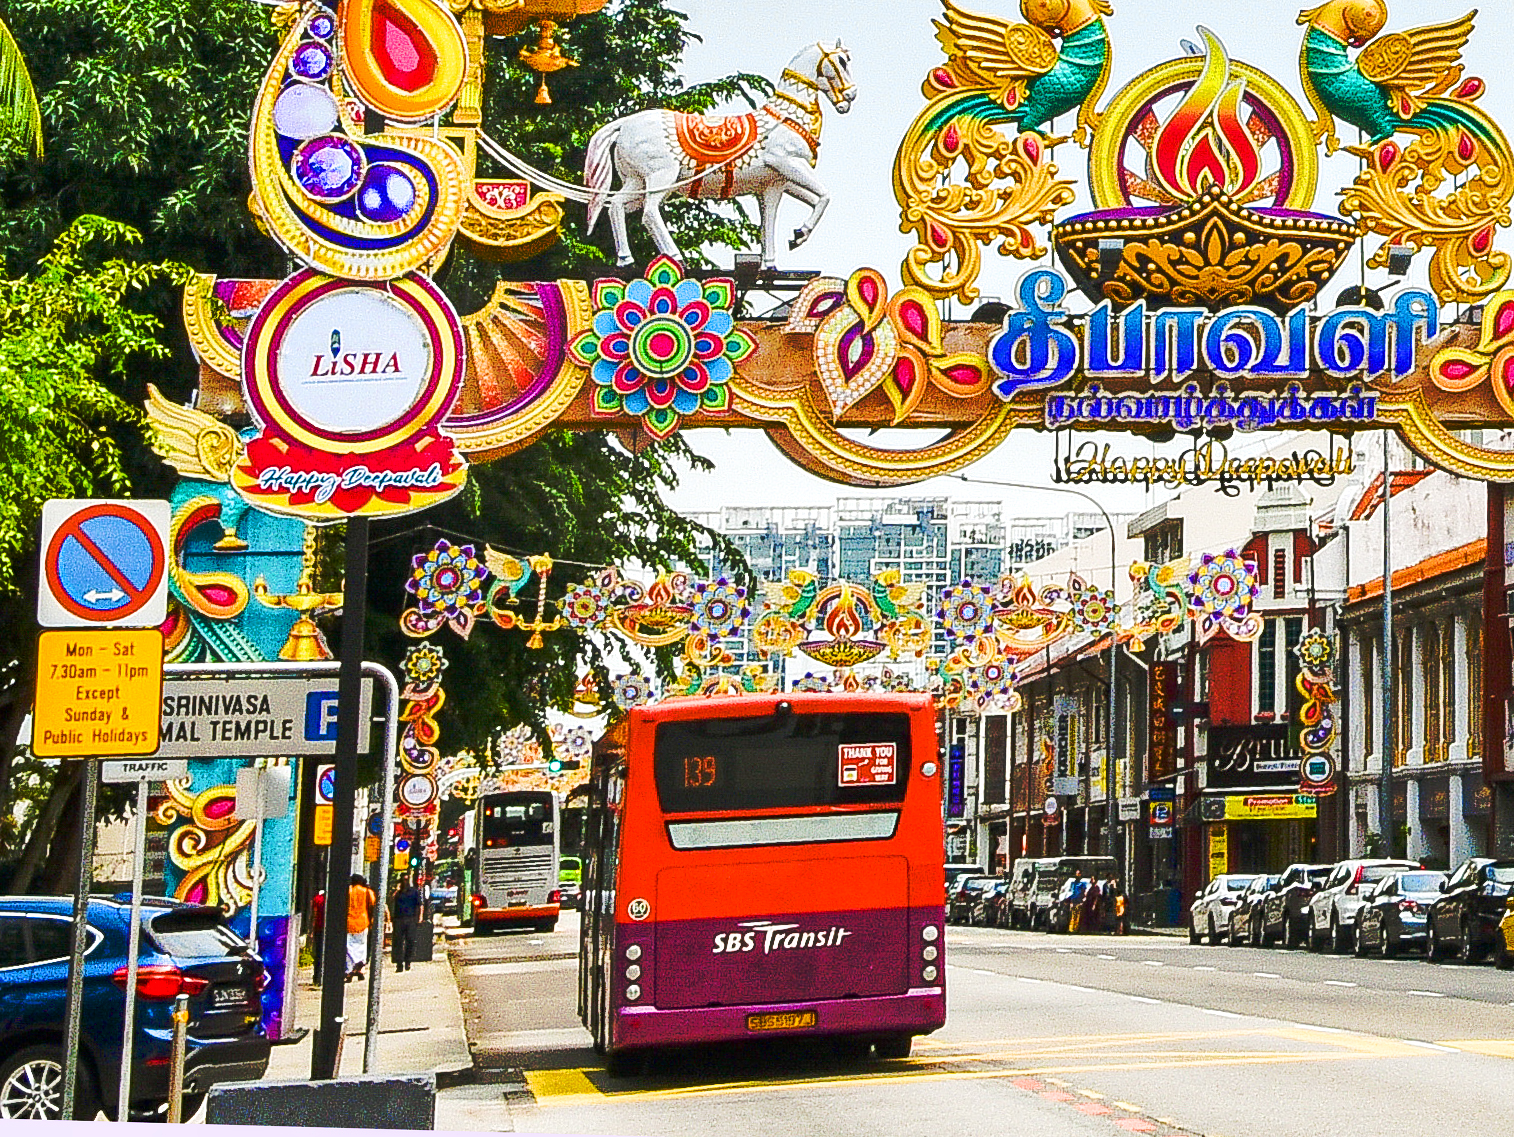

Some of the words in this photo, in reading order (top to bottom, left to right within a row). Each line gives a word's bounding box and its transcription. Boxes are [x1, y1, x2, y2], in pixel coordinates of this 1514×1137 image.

[989, 267, 1440, 400] தீபாவளி
[1065, 441, 1188, 487] Happy
[259, 466, 338, 504] Happy
[341, 463, 443, 492] Deepavali
[66, 642, 93, 657] Mon
[113, 642, 135, 657] Sat
[50, 664, 97, 680] 7.30am
[117, 662, 149, 680] 11pm
[76, 686, 121, 702] Except
[64, 707, 112, 724] Sunday
[121, 707, 130, 720] &
[163, 694, 271, 717] SRINIVASA
[43, 730, 84, 745] Public
[92, 729, 149, 744] Holidays
[209, 718, 294, 742] TEMPLE
[843, 747, 873, 759] THANK
[875, 746, 893, 758] YOU
[122, 762, 168, 773] TRAFFIC
[684, 756, 716, 787] 139
[712, 932, 756, 953] SBS
[753, 923, 853, 955] Transit
